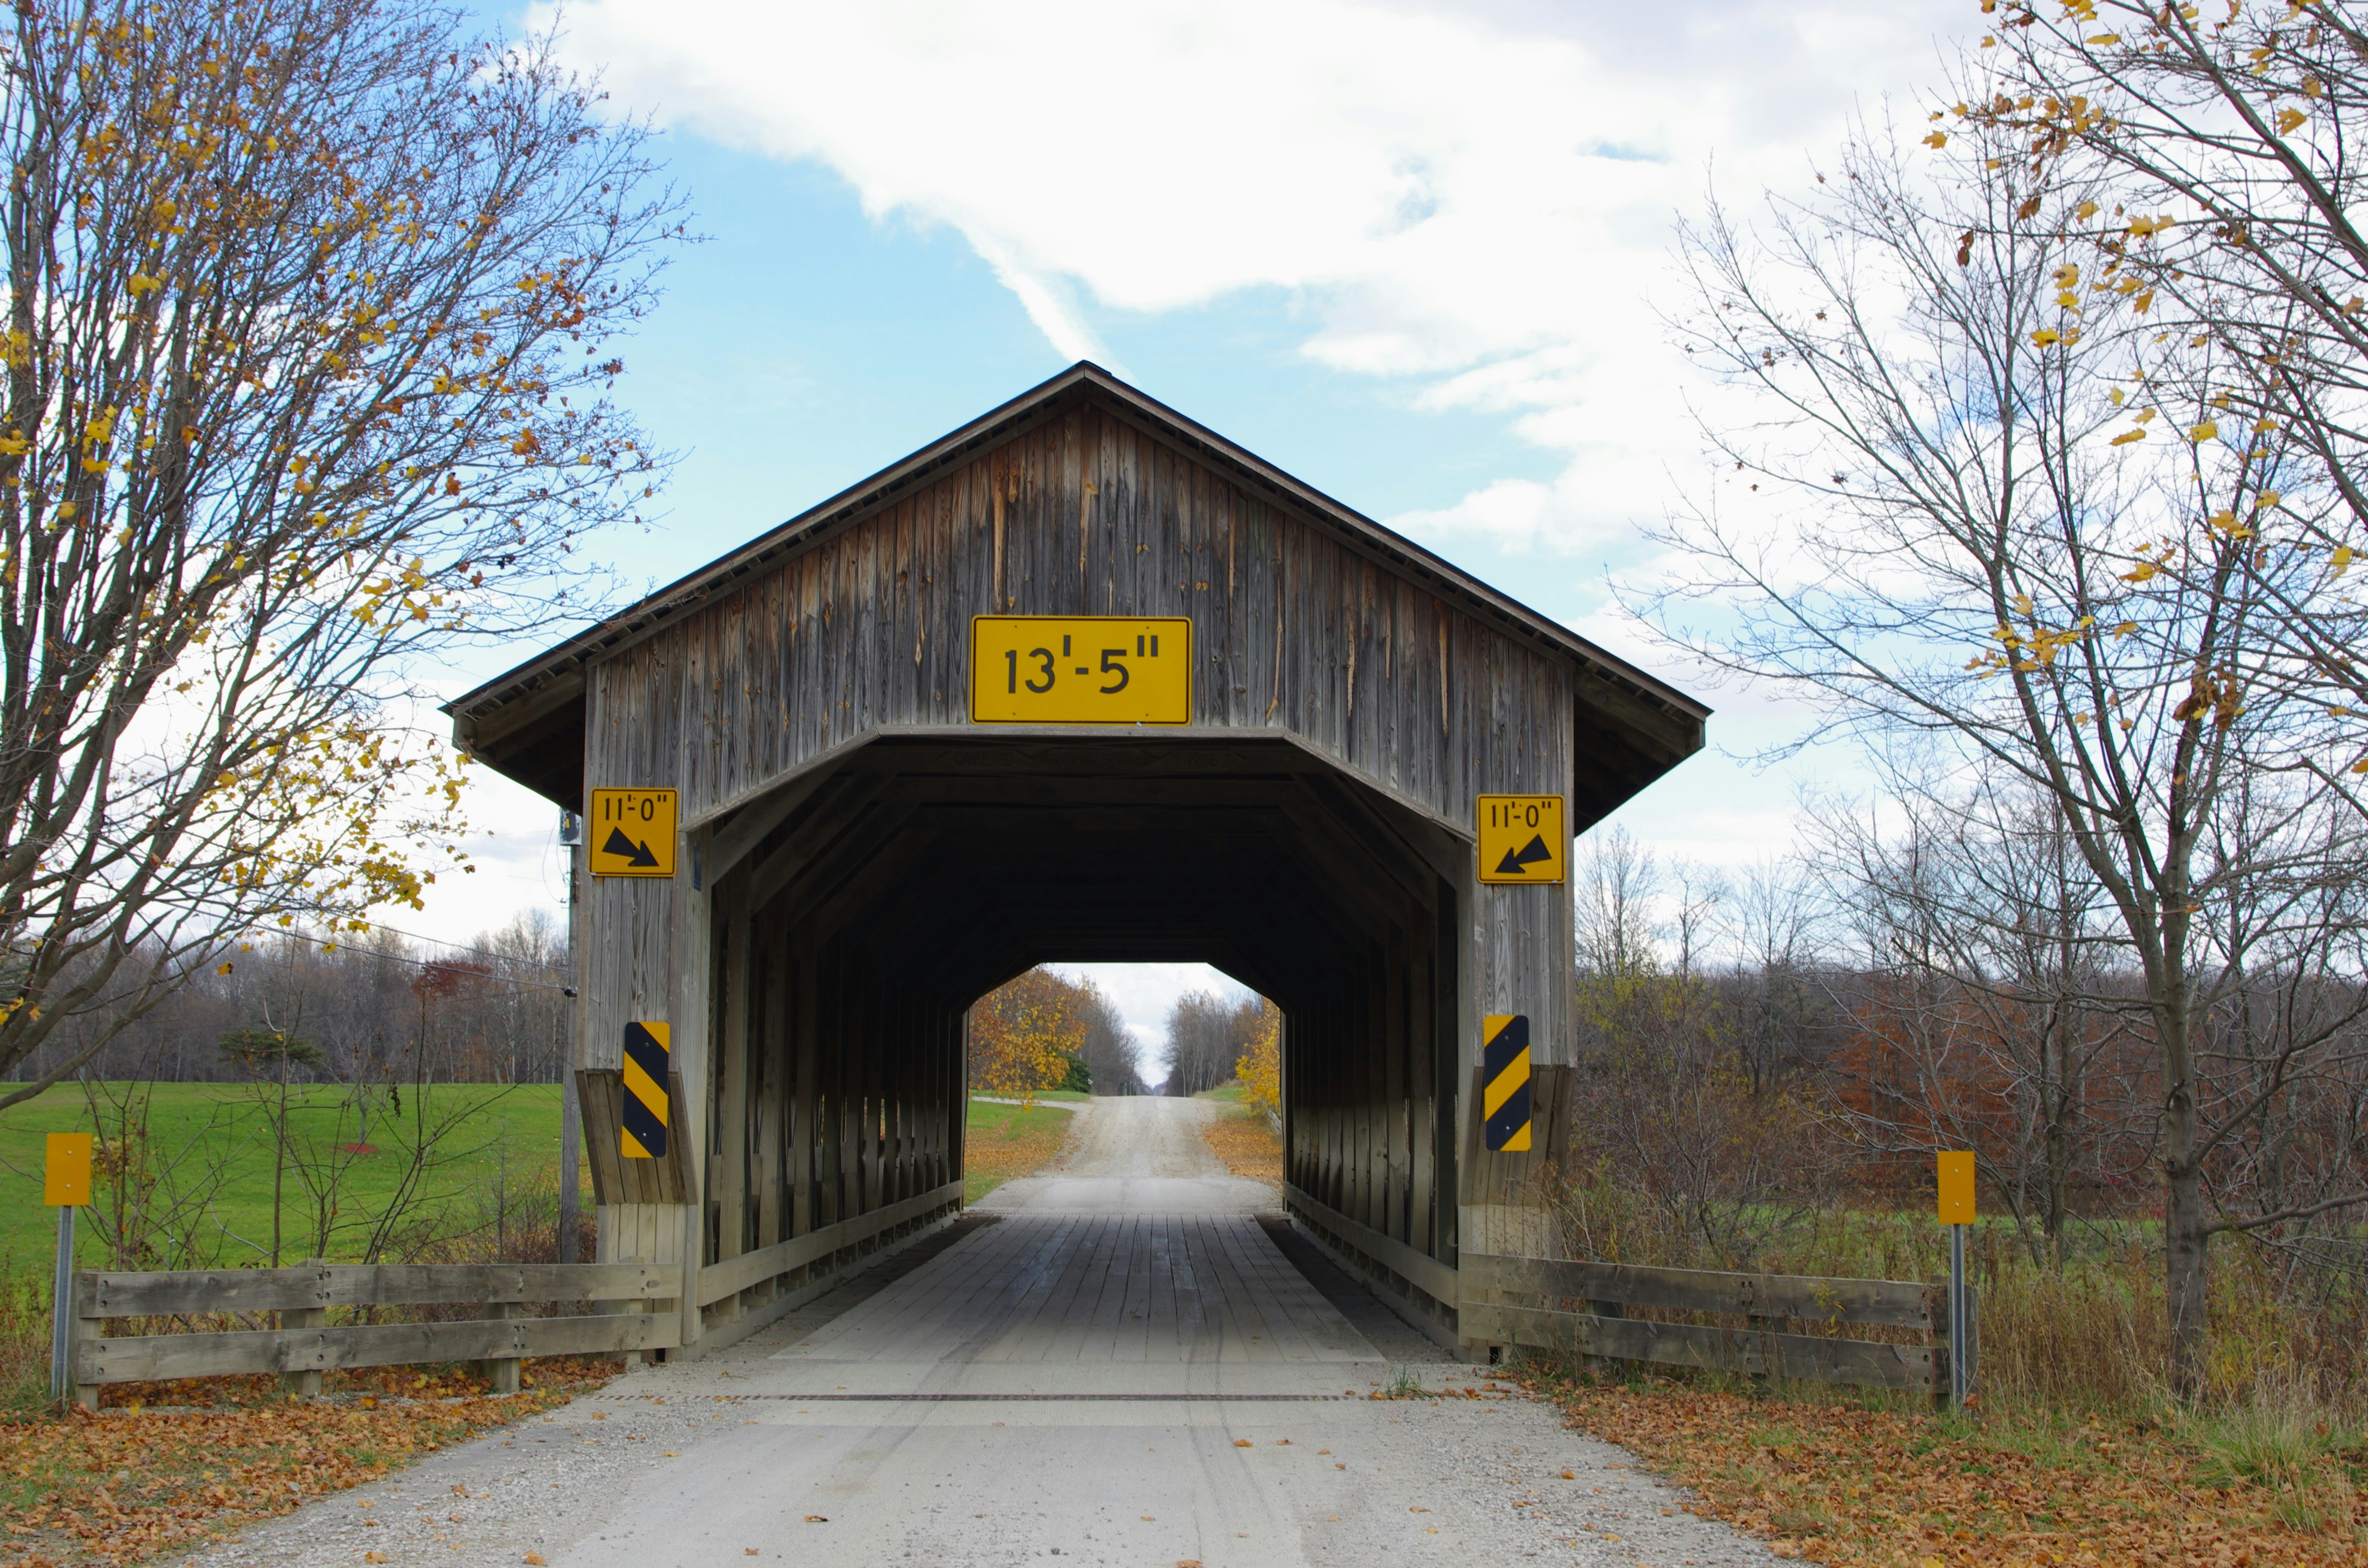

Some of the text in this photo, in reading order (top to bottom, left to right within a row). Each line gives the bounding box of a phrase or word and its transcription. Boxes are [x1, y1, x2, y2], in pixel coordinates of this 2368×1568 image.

[1005, 635, 1158, 694] 13'-5"
[1187, 753, 1219, 767] 1986
[605, 794, 667, 821] 11'-0"
[1491, 801, 1551, 828] 11'-0"
